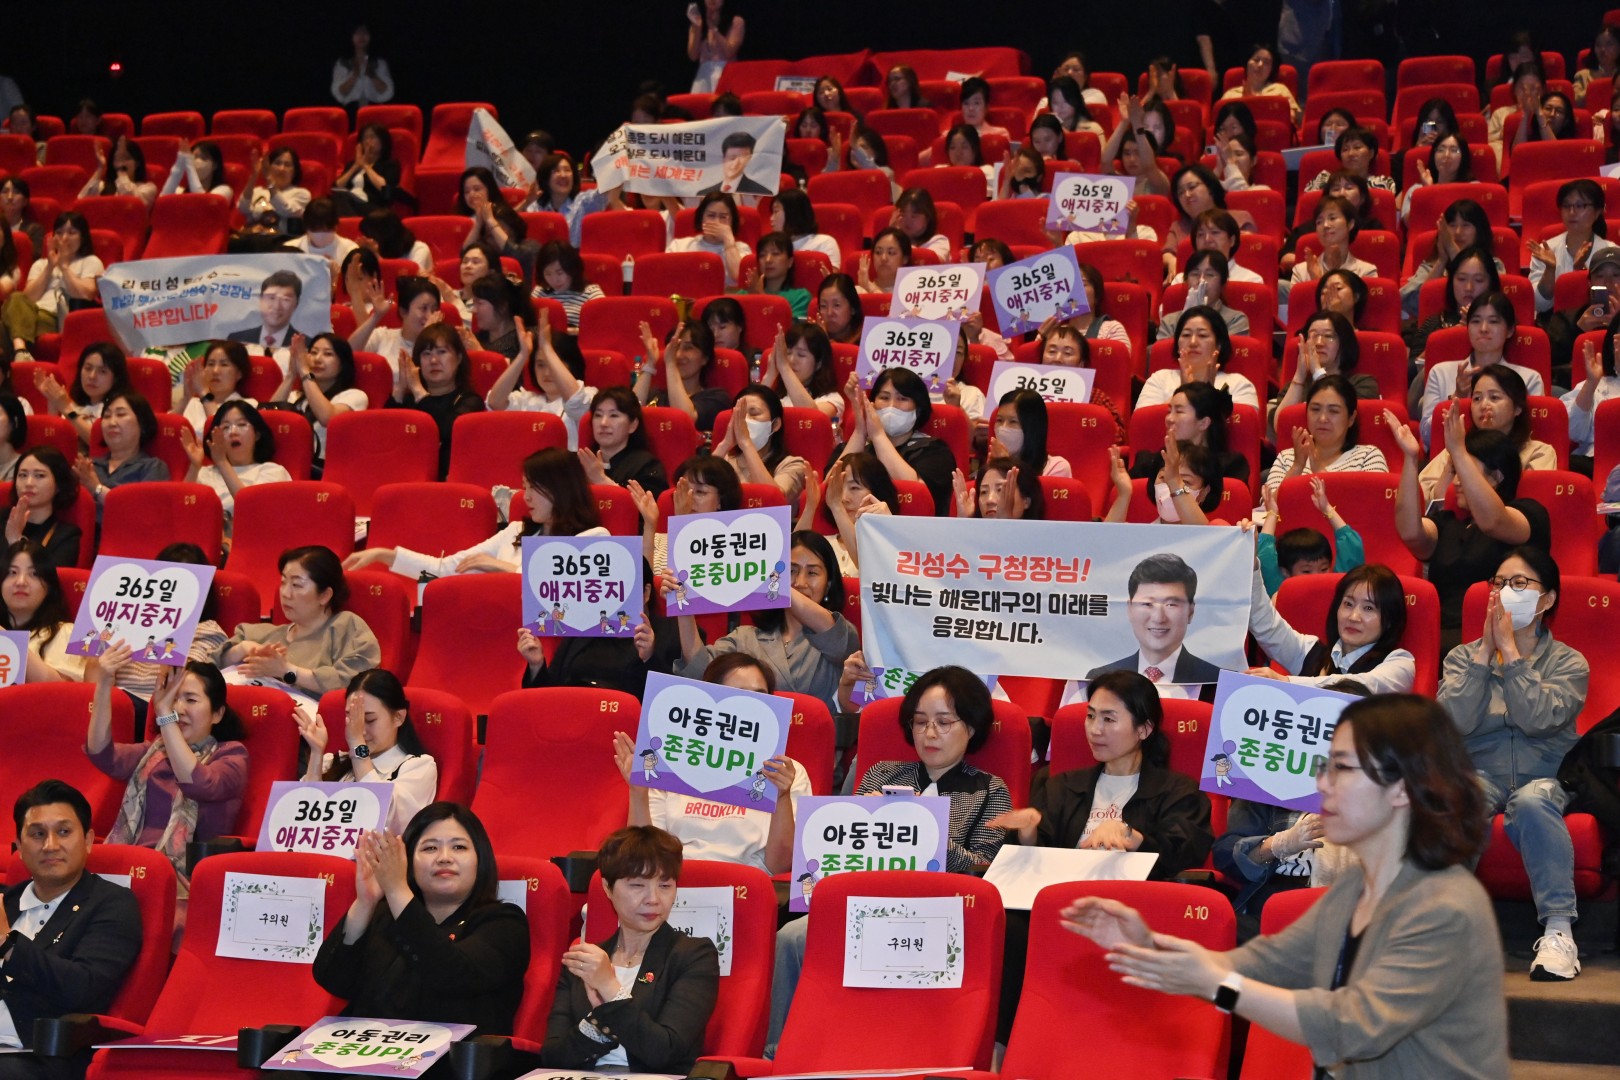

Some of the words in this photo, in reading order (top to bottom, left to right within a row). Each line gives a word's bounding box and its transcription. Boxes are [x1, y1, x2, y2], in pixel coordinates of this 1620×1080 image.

[649, 132, 669, 145] 도시
[654, 166, 703, 182] 세계로!
[1072, 184, 1113, 199] 365일
[1061, 198, 1119, 214] 애지중지
[165, 276, 179, 291] 성
[917, 273, 962, 289] 365일
[1011, 262, 1055, 291] 365일
[904, 288, 969, 305] 애지중지
[1006, 278, 1071, 310] 애지중지
[132, 304, 211, 330] 사랑합니다
[885, 330, 934, 349] 365일
[1374, 342, 1390, 352] F11
[1517, 335, 1533, 345] F10
[871, 348, 941, 368] 애지중지
[1015, 376, 1066, 394] 365일
[1374, 415, 1387, 425] E1
[1531, 408, 1548, 419] E10
[532, 422, 545, 432] E17
[798, 419, 812, 430] E15
[1081, 417, 1097, 428] E13
[316, 492, 329, 503] D17
[897, 492, 913, 503] D13
[1052, 488, 1069, 499] D12
[1385, 487, 1398, 499] D1
[598, 499, 612, 510] D15
[748, 497, 763, 508] D14
[689, 532, 767, 560] 아동권리
[551, 554, 611, 577] 365일
[688, 558, 767, 588] 존중UP!
[896, 551, 970, 580] 김성수
[977, 554, 1092, 584] 구청장님!
[115, 576, 177, 602] 365일
[539, 578, 625, 603] 애지중지
[848, 594, 861, 606] C1
[871, 581, 933, 607] 빛나는
[938, 588, 1042, 615] 해운대구의
[1048, 591, 1109, 617] 미래를
[95, 600, 183, 629] 애지중지
[932, 615, 1044, 645] 응원합니다.
[251, 705, 268, 717] B15
[600, 700, 619, 713] B13
[426, 711, 442, 724] B14
[668, 705, 760, 743] 아동권리
[790, 712, 804, 725] 12
[1177, 719, 1198, 733] B10
[662, 733, 756, 777] 존중UP!
[294, 799, 357, 824] 365일
[684, 801, 747, 818] BROOKLYN
[275, 825, 363, 851] 애지중지
[822, 822, 919, 850] 아동권리
[129, 865, 147, 880] A15
[729, 885, 748, 900] 12
[258, 912, 289, 928] 구의원
[1183, 904, 1209, 921] A10
[887, 937, 924, 952] 구의원
[331, 1028, 431, 1045] 아동권리
[311, 1040, 414, 1060] 존중UP!
